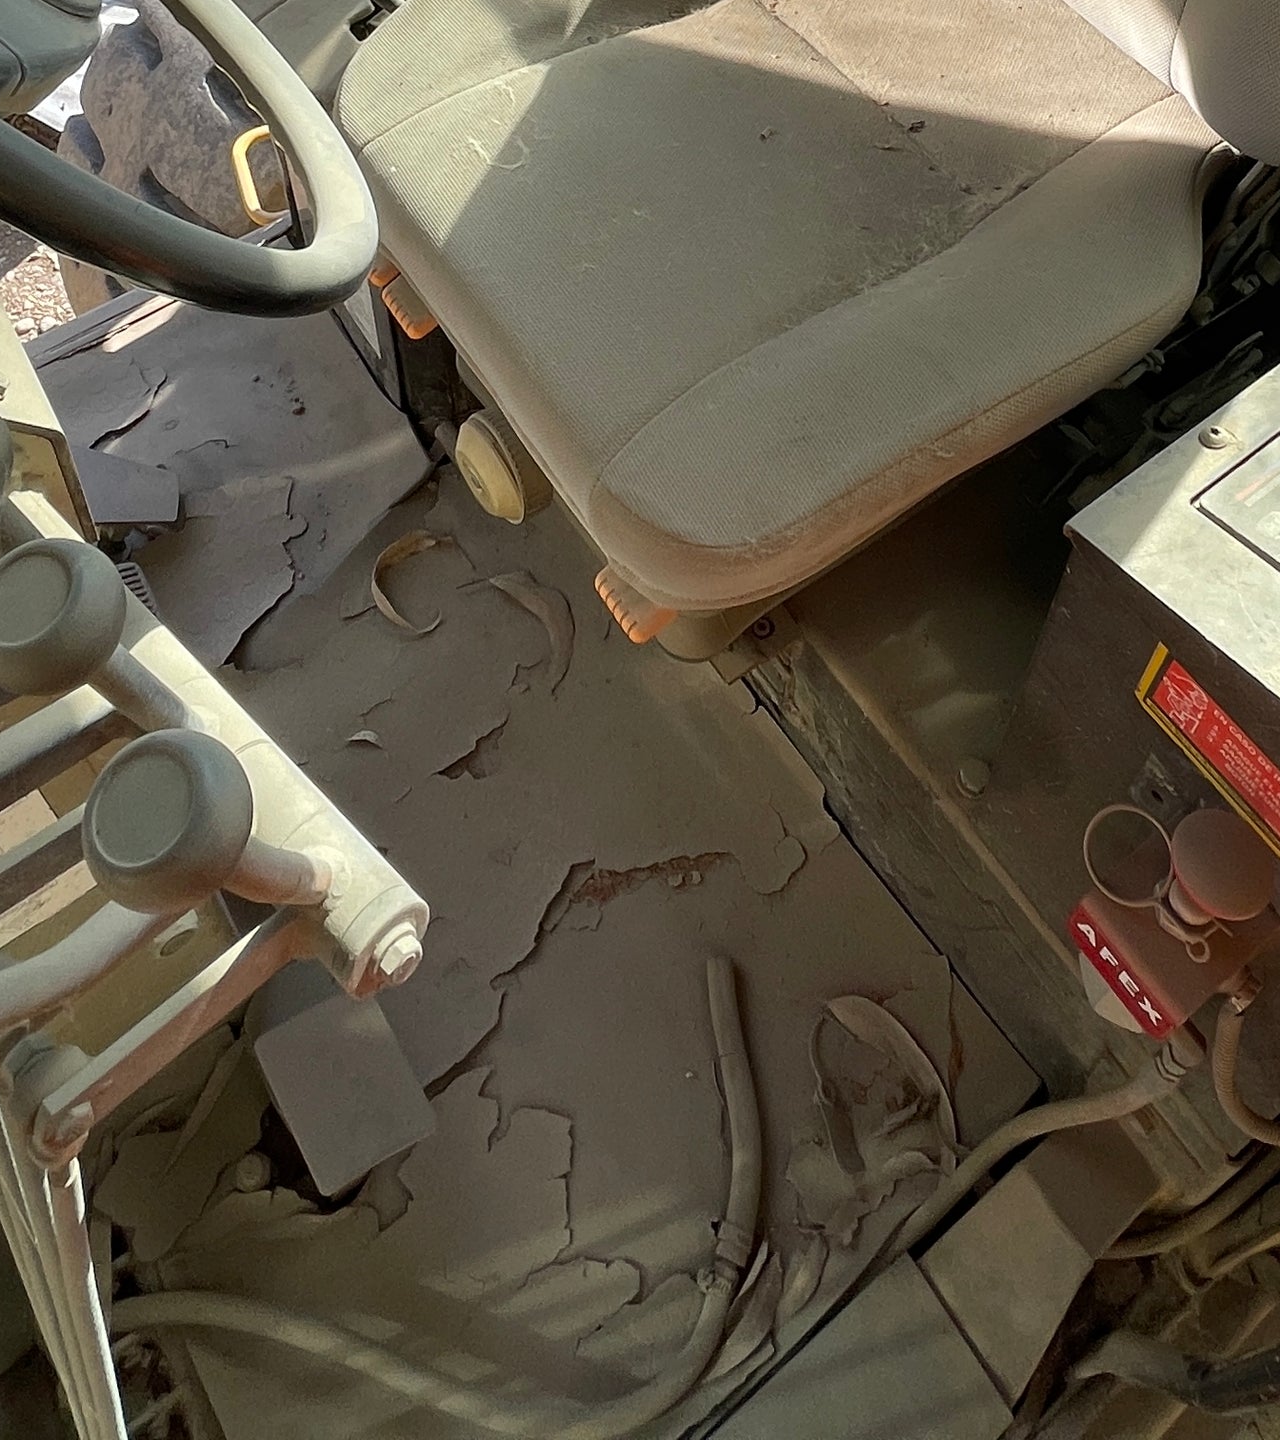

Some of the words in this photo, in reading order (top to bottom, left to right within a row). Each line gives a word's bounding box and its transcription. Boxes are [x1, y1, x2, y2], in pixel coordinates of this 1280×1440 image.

[1213, 709, 1228, 725] EN
[1229, 725, 1257, 756] CASO
[1077, 923, 1162, 1026] AFEX
